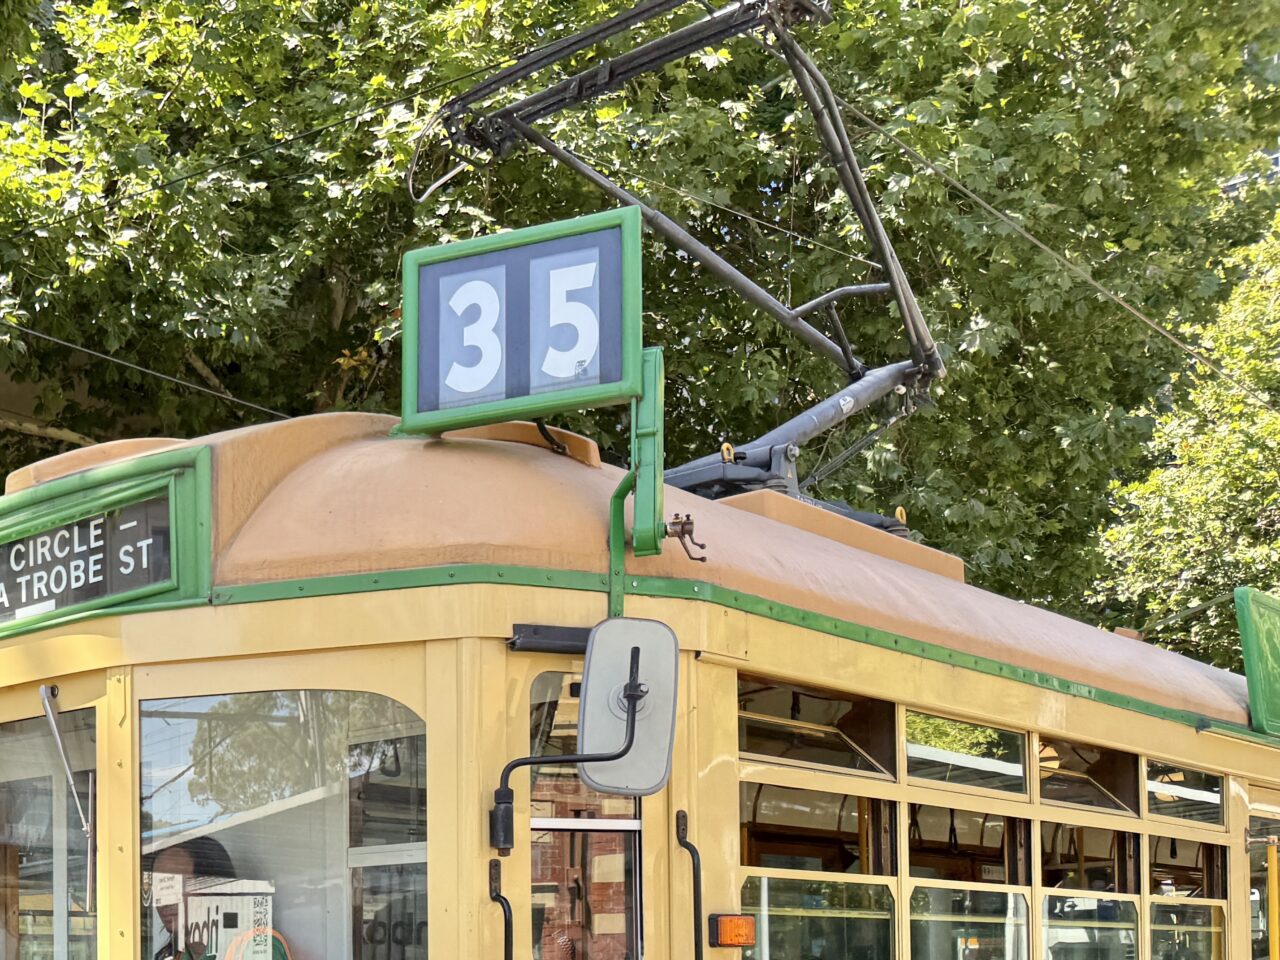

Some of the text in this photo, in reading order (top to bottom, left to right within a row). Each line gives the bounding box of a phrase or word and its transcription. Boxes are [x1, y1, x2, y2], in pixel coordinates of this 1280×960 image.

[444, 262, 600, 393] 35
[9, 517, 105, 572] CIRCLE
[15, 552, 104, 604] TROBE
[118, 537, 153, 576] ST
